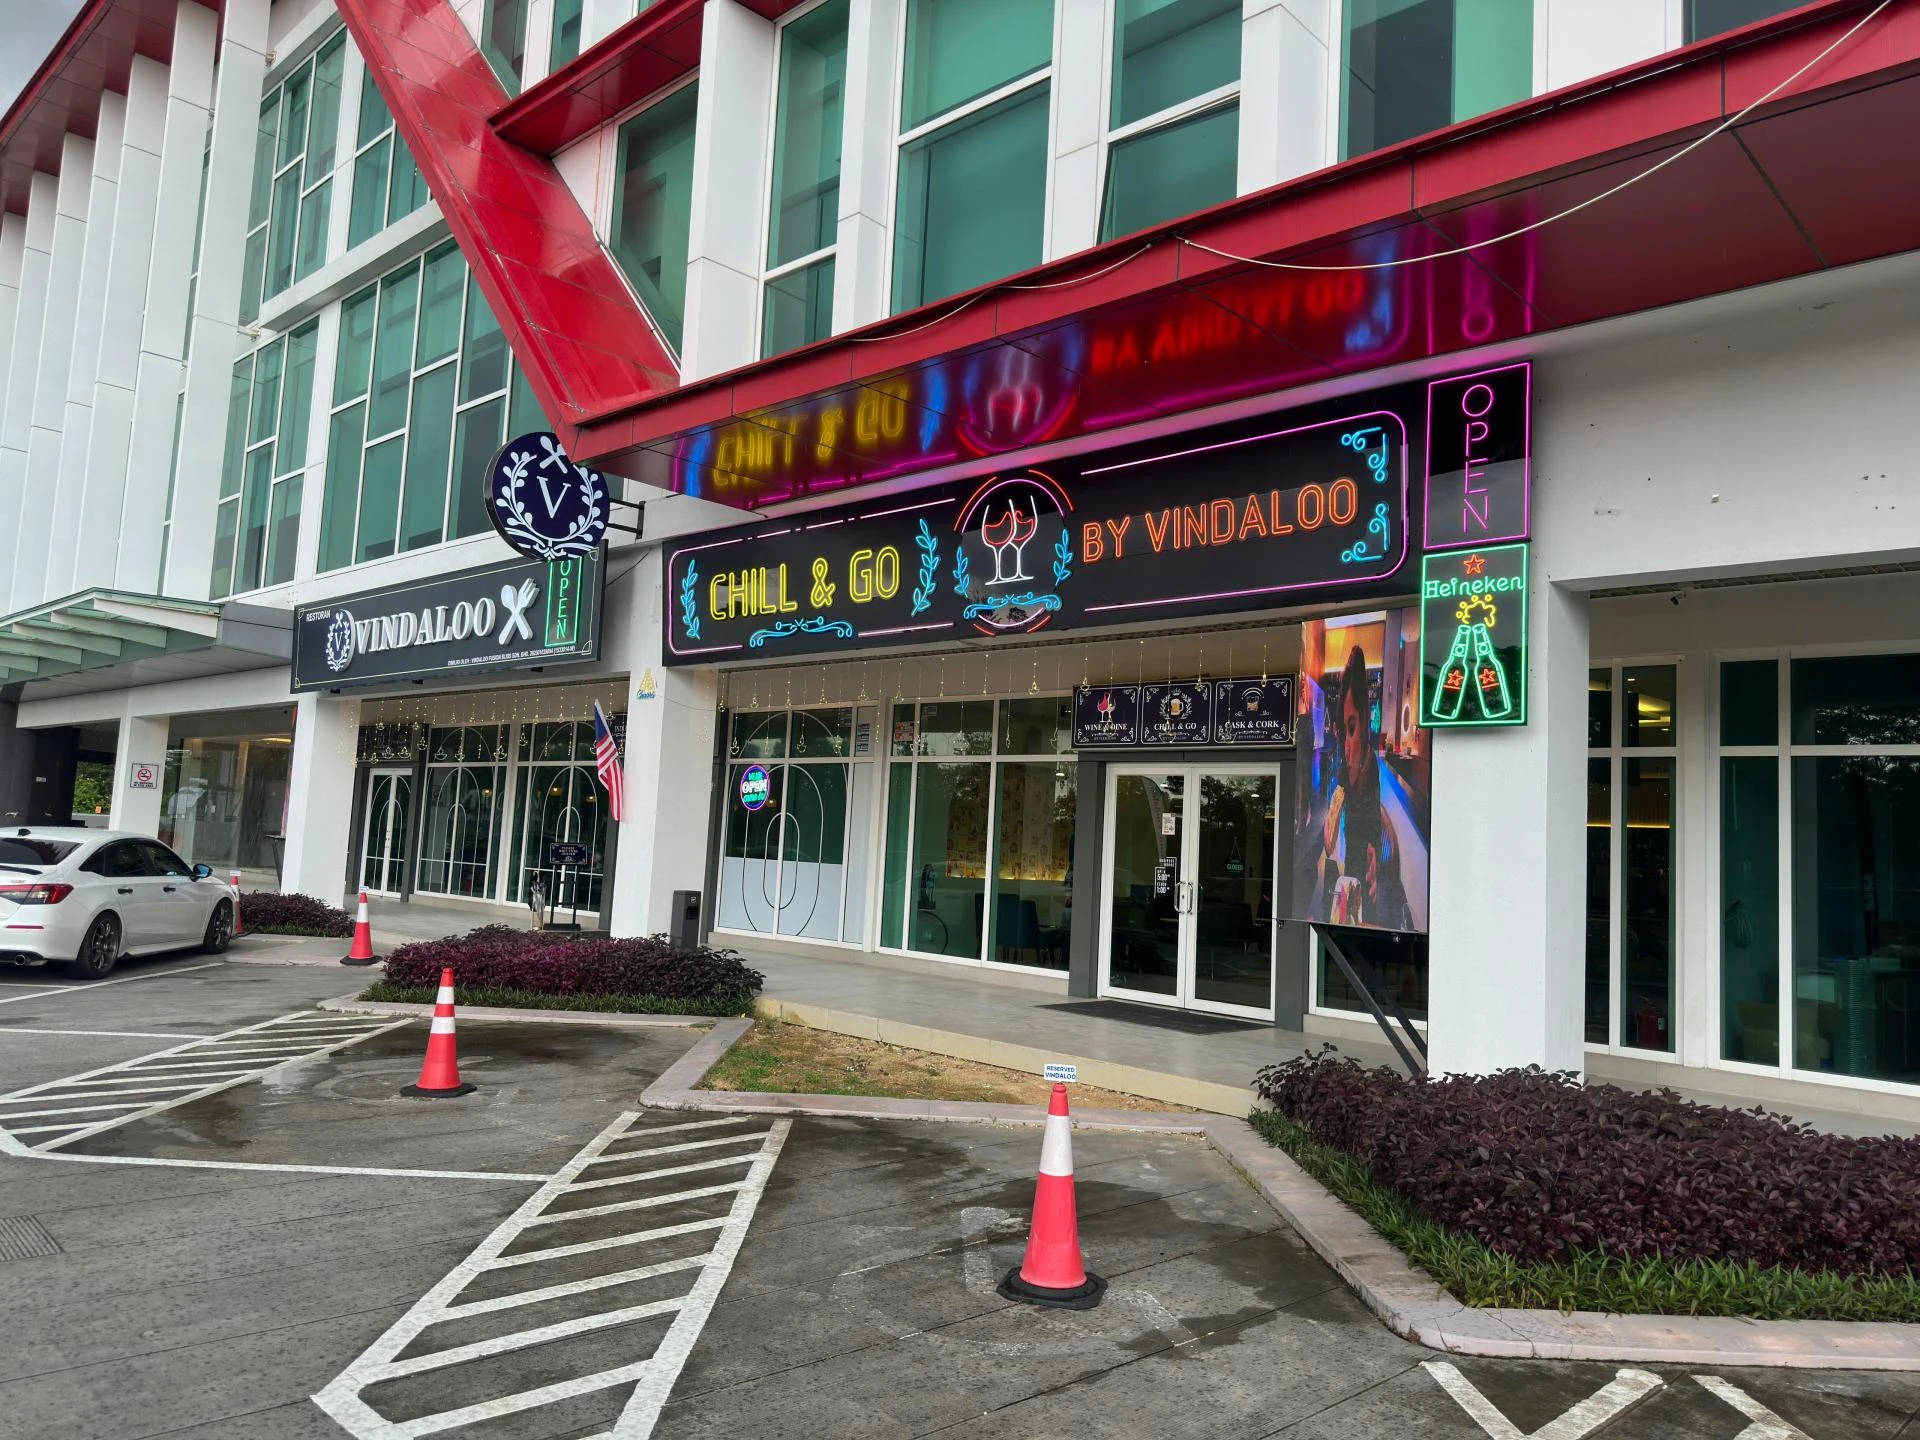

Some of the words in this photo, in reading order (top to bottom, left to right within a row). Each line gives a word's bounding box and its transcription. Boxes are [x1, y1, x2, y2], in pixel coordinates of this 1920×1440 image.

[1461, 384, 1494, 533] OPEN
[537, 475, 571, 519] V
[1082, 515, 1130, 564] BY
[1144, 478, 1359, 553] VINDALOO
[709, 563, 798, 620] CHILL
[810, 557, 836, 608] &
[849, 546, 900, 603] GO
[1424, 575, 1524, 599] Heineken
[306, 610, 331, 621] RESTORAN
[355, 597, 496, 654] VINDALOO
[1084, 723, 1102, 731] WINE
[1178, 722, 1184, 730] &
[1185, 722, 1197, 730] GO
[1225, 721, 1246, 729] CASK
[1247, 720, 1254, 728] &
[1256, 720, 1279, 728] CORK
[742, 779, 768, 793] OPEN
[1045, 1072, 1077, 1080] VINDALOO
